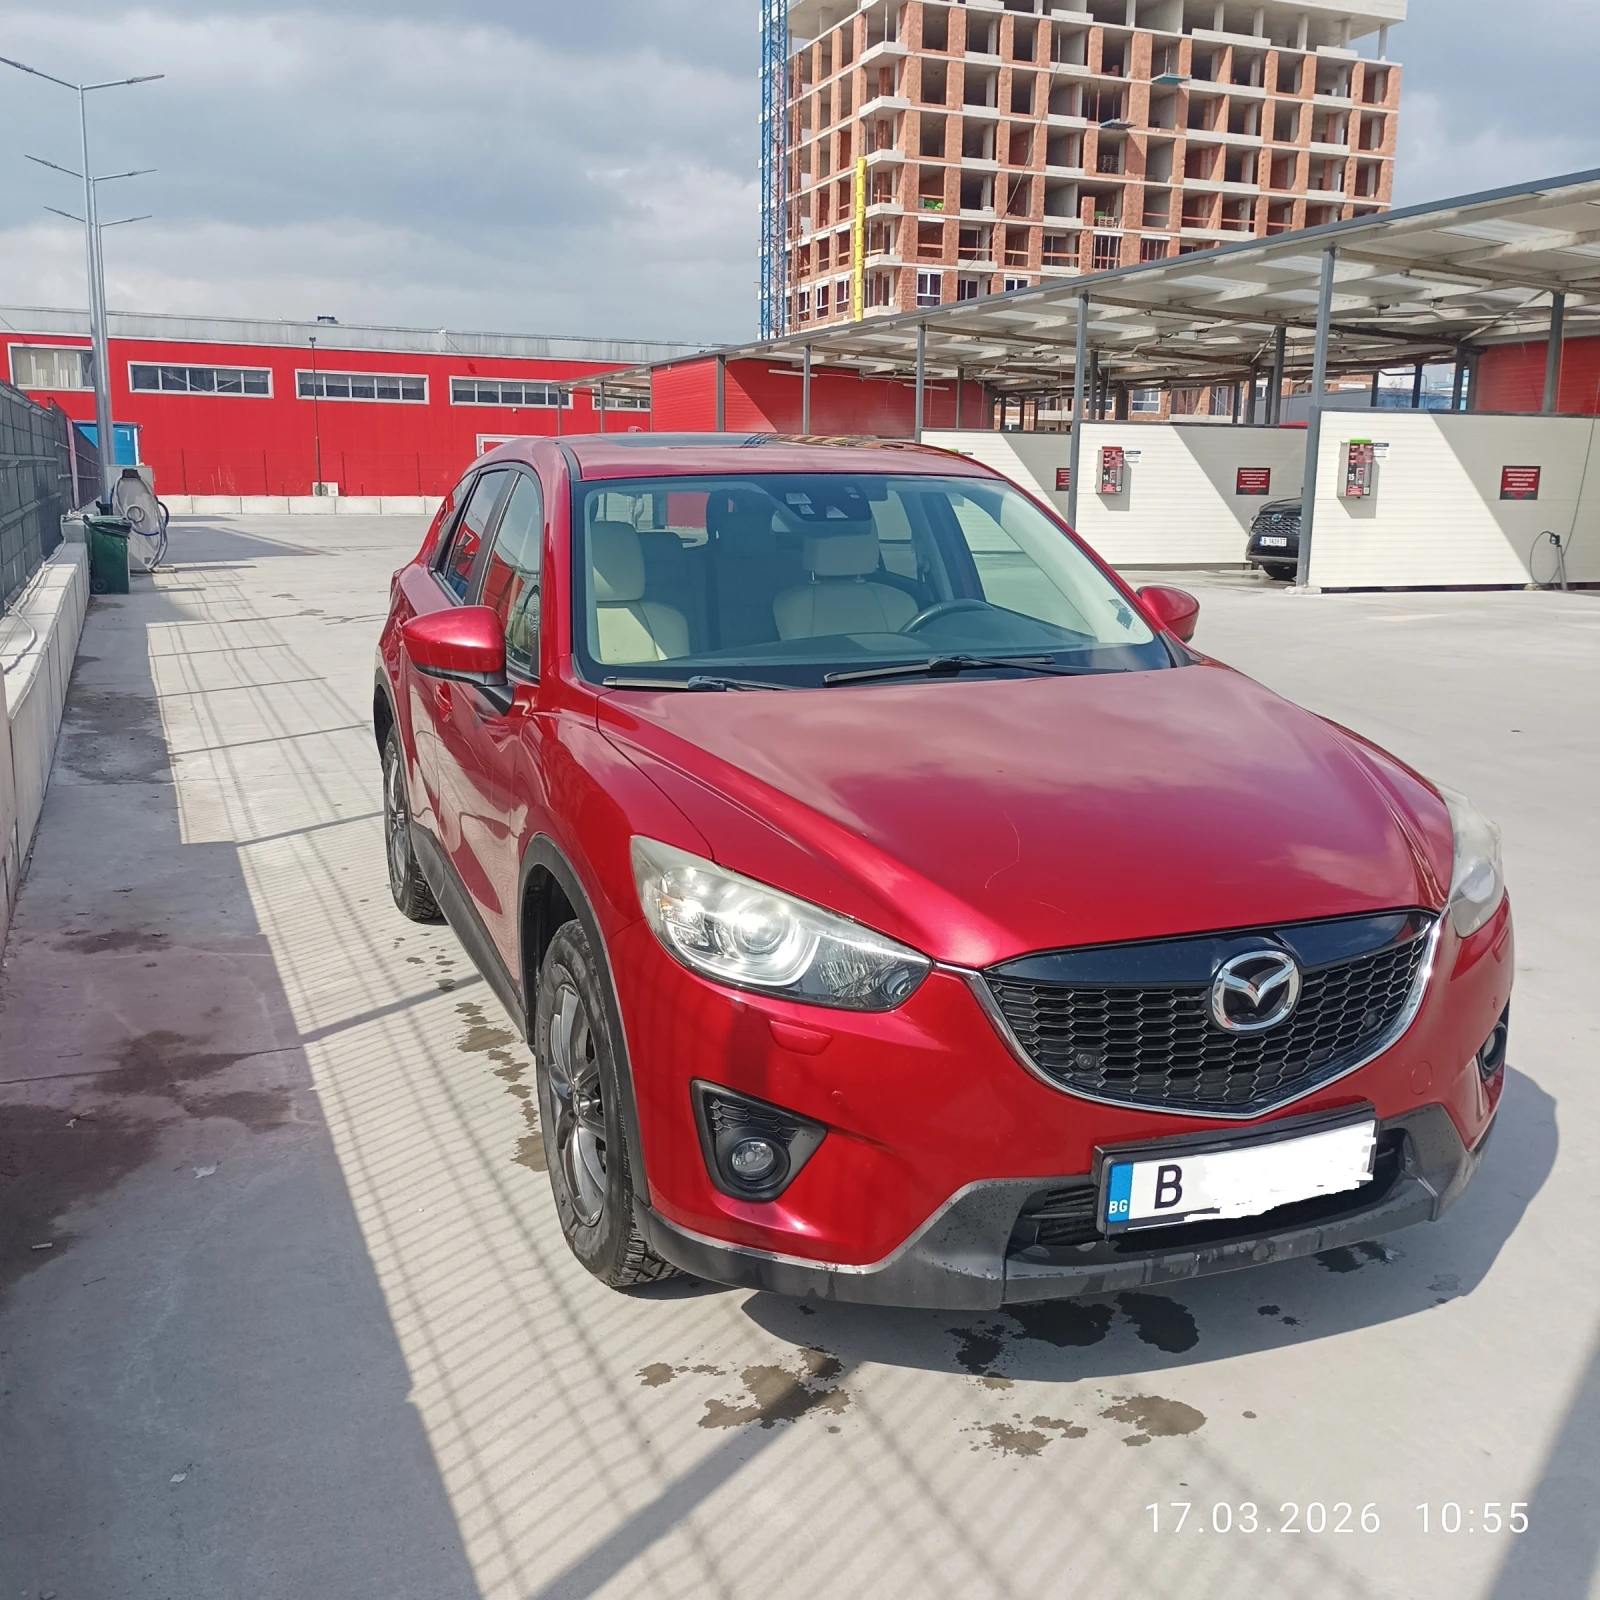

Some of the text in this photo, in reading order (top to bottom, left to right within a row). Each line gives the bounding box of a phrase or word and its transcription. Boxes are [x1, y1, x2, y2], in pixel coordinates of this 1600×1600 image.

[1348, 473, 1355, 481] 15
[1154, 1164, 1183, 1210] B
[1108, 1199, 1128, 1215] BG
